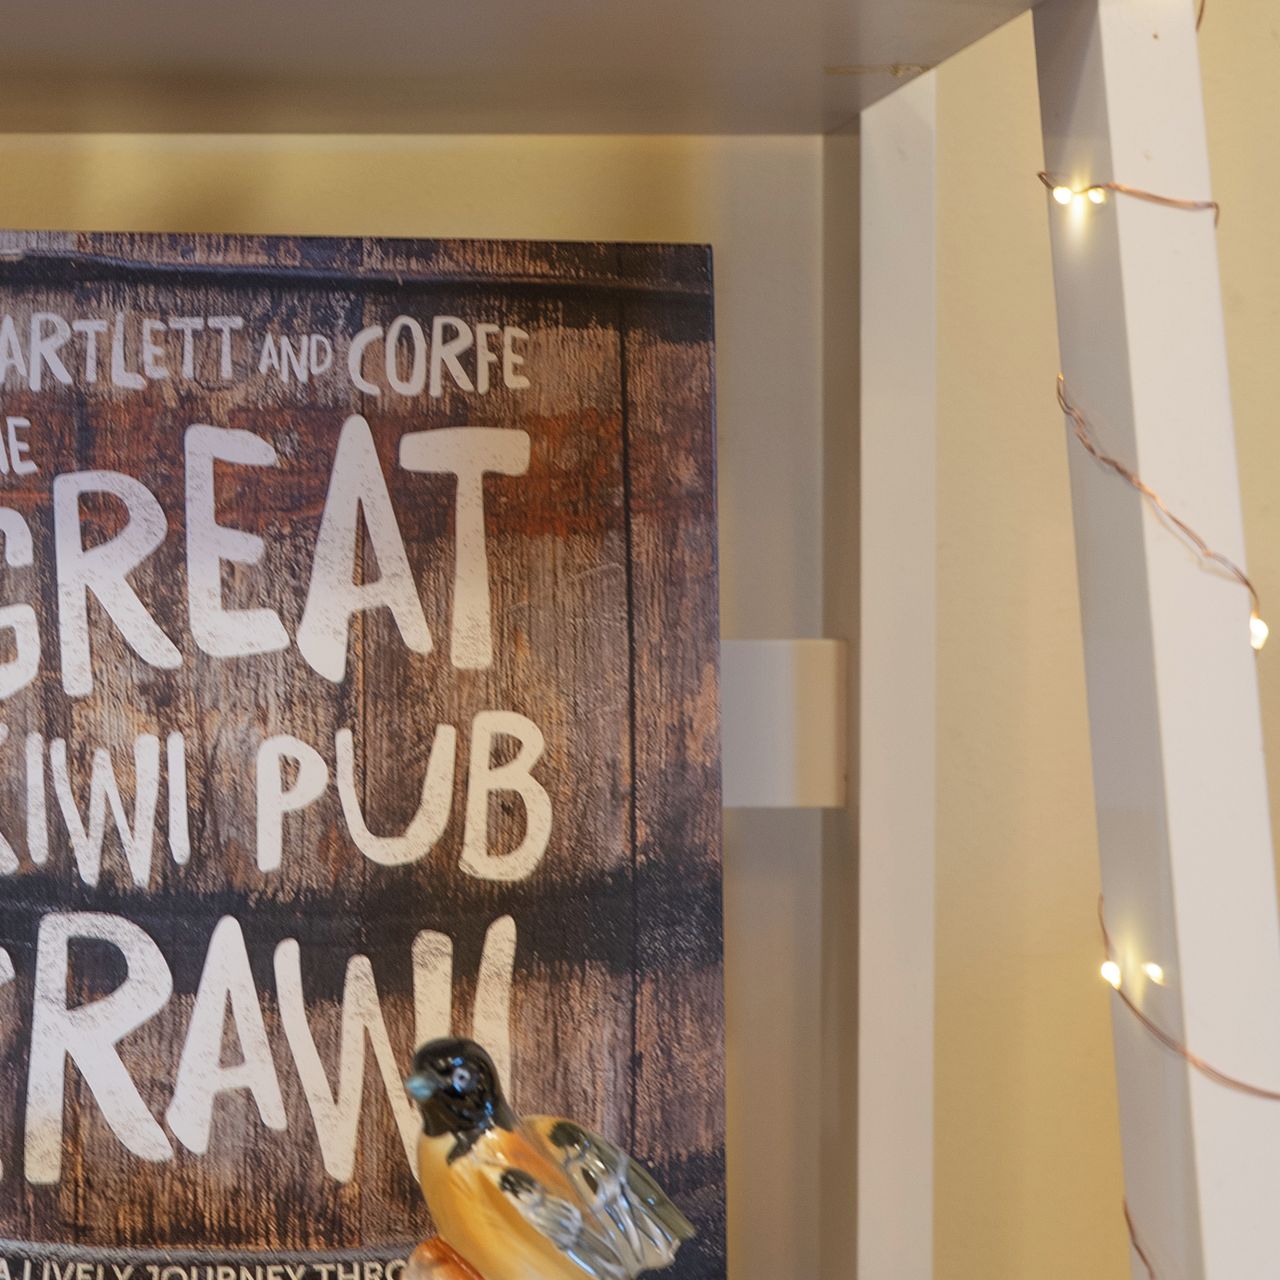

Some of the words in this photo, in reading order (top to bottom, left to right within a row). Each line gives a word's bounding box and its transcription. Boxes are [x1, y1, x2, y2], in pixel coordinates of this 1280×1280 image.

[258, 333, 333, 384] AND
[347, 314, 531, 398] CORFE
[256, 710, 553, 883] PUB
